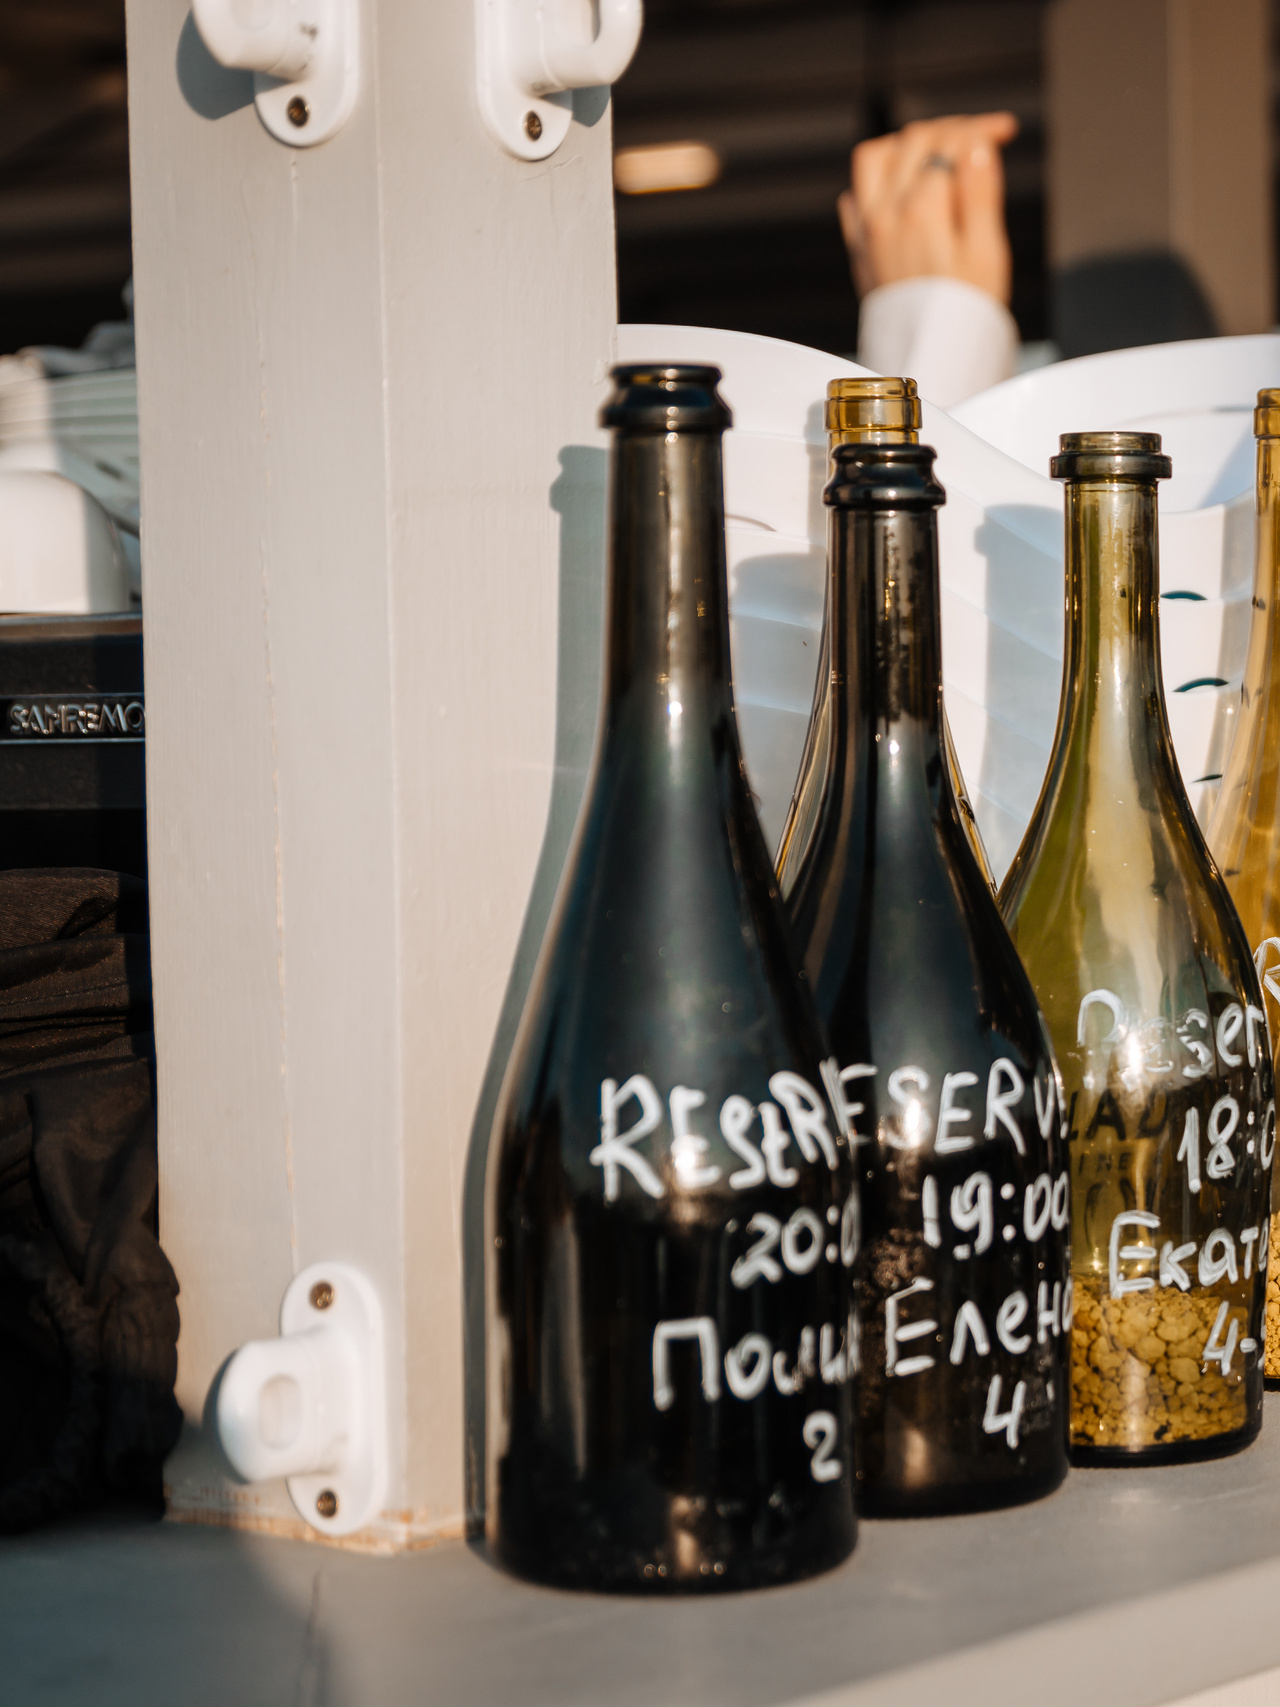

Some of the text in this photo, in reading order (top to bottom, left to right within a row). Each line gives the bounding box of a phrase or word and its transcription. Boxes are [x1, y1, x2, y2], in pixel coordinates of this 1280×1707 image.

[11, 702, 145, 735] SANREMO
[922, 1171, 1070, 1260] 19:00
[803, 1410, 842, 1483] 2
